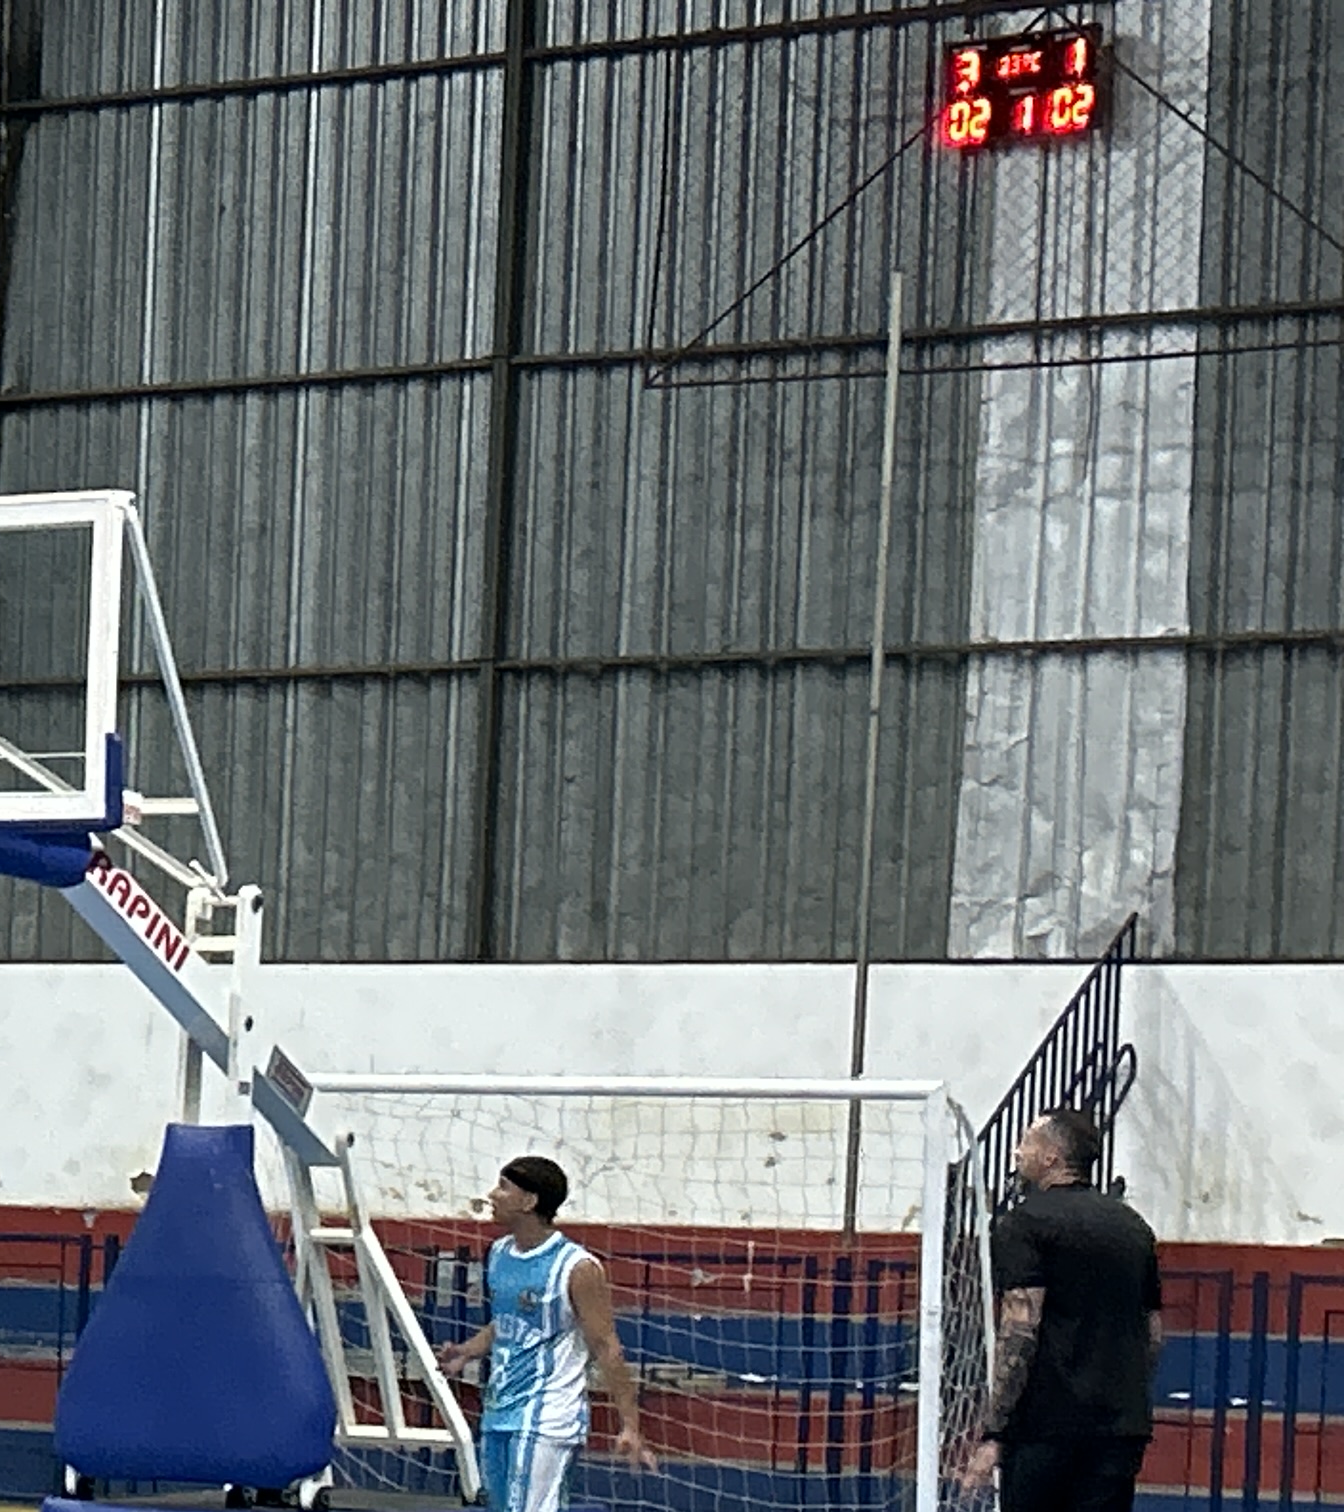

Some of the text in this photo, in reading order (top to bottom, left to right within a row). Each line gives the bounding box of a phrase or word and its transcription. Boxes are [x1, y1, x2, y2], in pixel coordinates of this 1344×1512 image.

[956, 50, 980, 93] 3
[1069, 37, 1087, 78] 1
[948, 83, 1095, 142] 02 1 02
